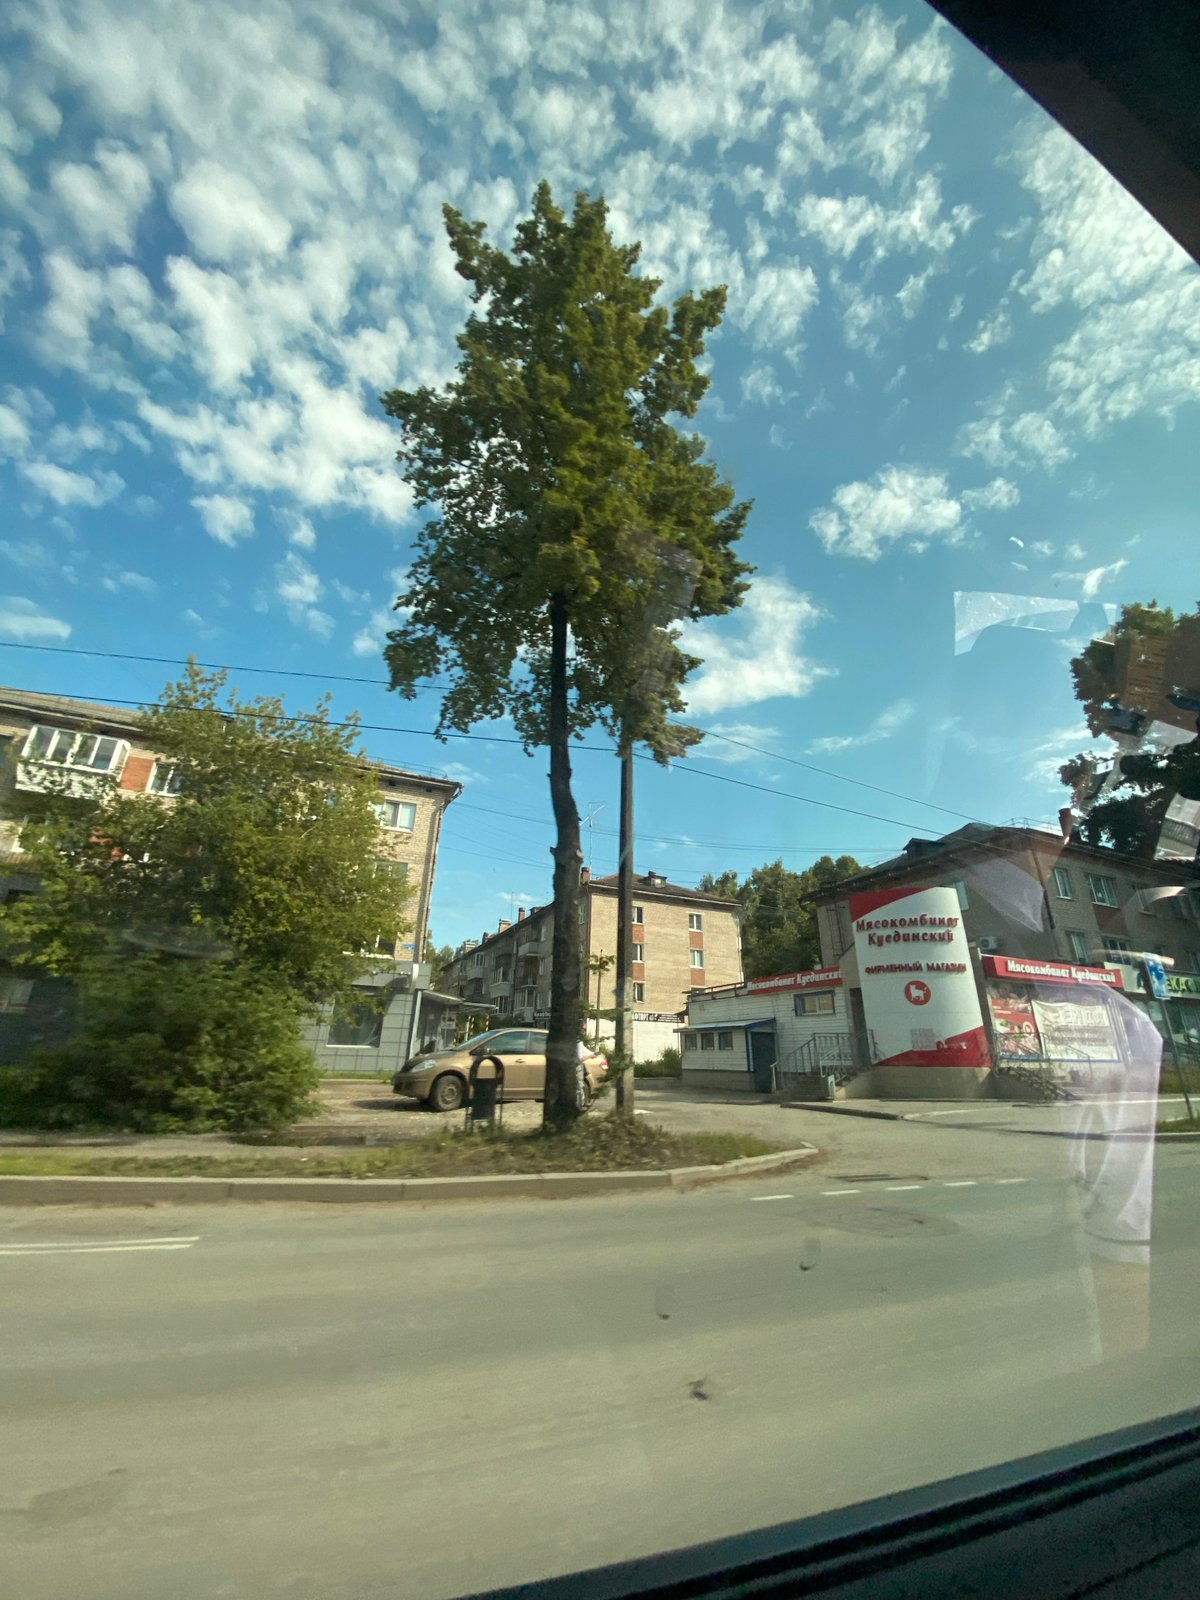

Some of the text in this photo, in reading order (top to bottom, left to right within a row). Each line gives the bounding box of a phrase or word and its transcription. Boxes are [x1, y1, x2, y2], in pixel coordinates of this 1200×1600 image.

[856, 914, 960, 932] Мясокомбинат
[868, 929, 954, 947] Куединский
[865, 961, 967, 975] ФИРМЕННЫЙ МАГАЗИН
[1007, 960, 1116, 983] Мясокомбинат Куединский
